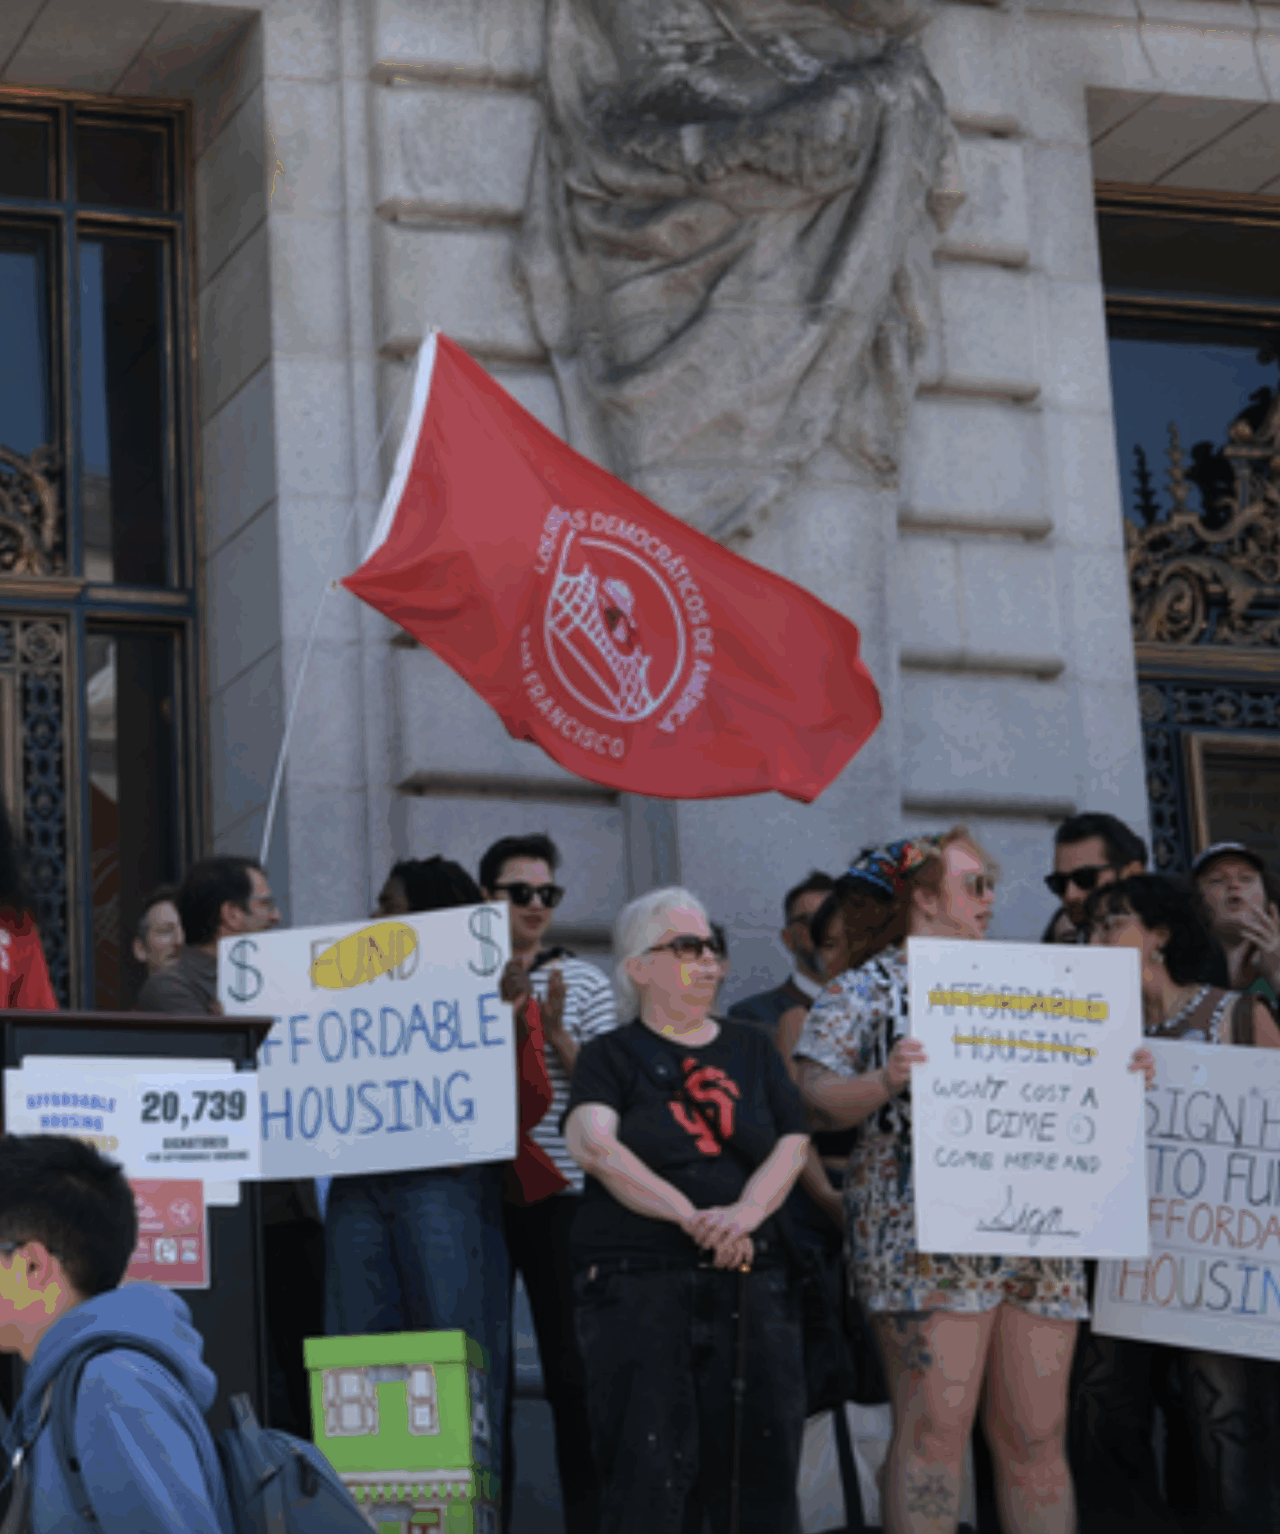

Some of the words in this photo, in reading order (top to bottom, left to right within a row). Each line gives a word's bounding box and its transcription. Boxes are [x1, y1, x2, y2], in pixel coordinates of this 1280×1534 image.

[309, 928, 419, 990] FUND
[926, 981, 1109, 1024] AFFORDABLE
[261, 992, 505, 1066] FFORDABLE
[953, 1025, 1096, 1067] HOUSING
[140, 1090, 247, 1132] 20,739
[260, 1070, 475, 1140] HOUSING
[1080, 1086, 1099, 1109] A
[985, 1107, 1060, 1143] DIME
[1146, 1143, 1206, 1199] TO
